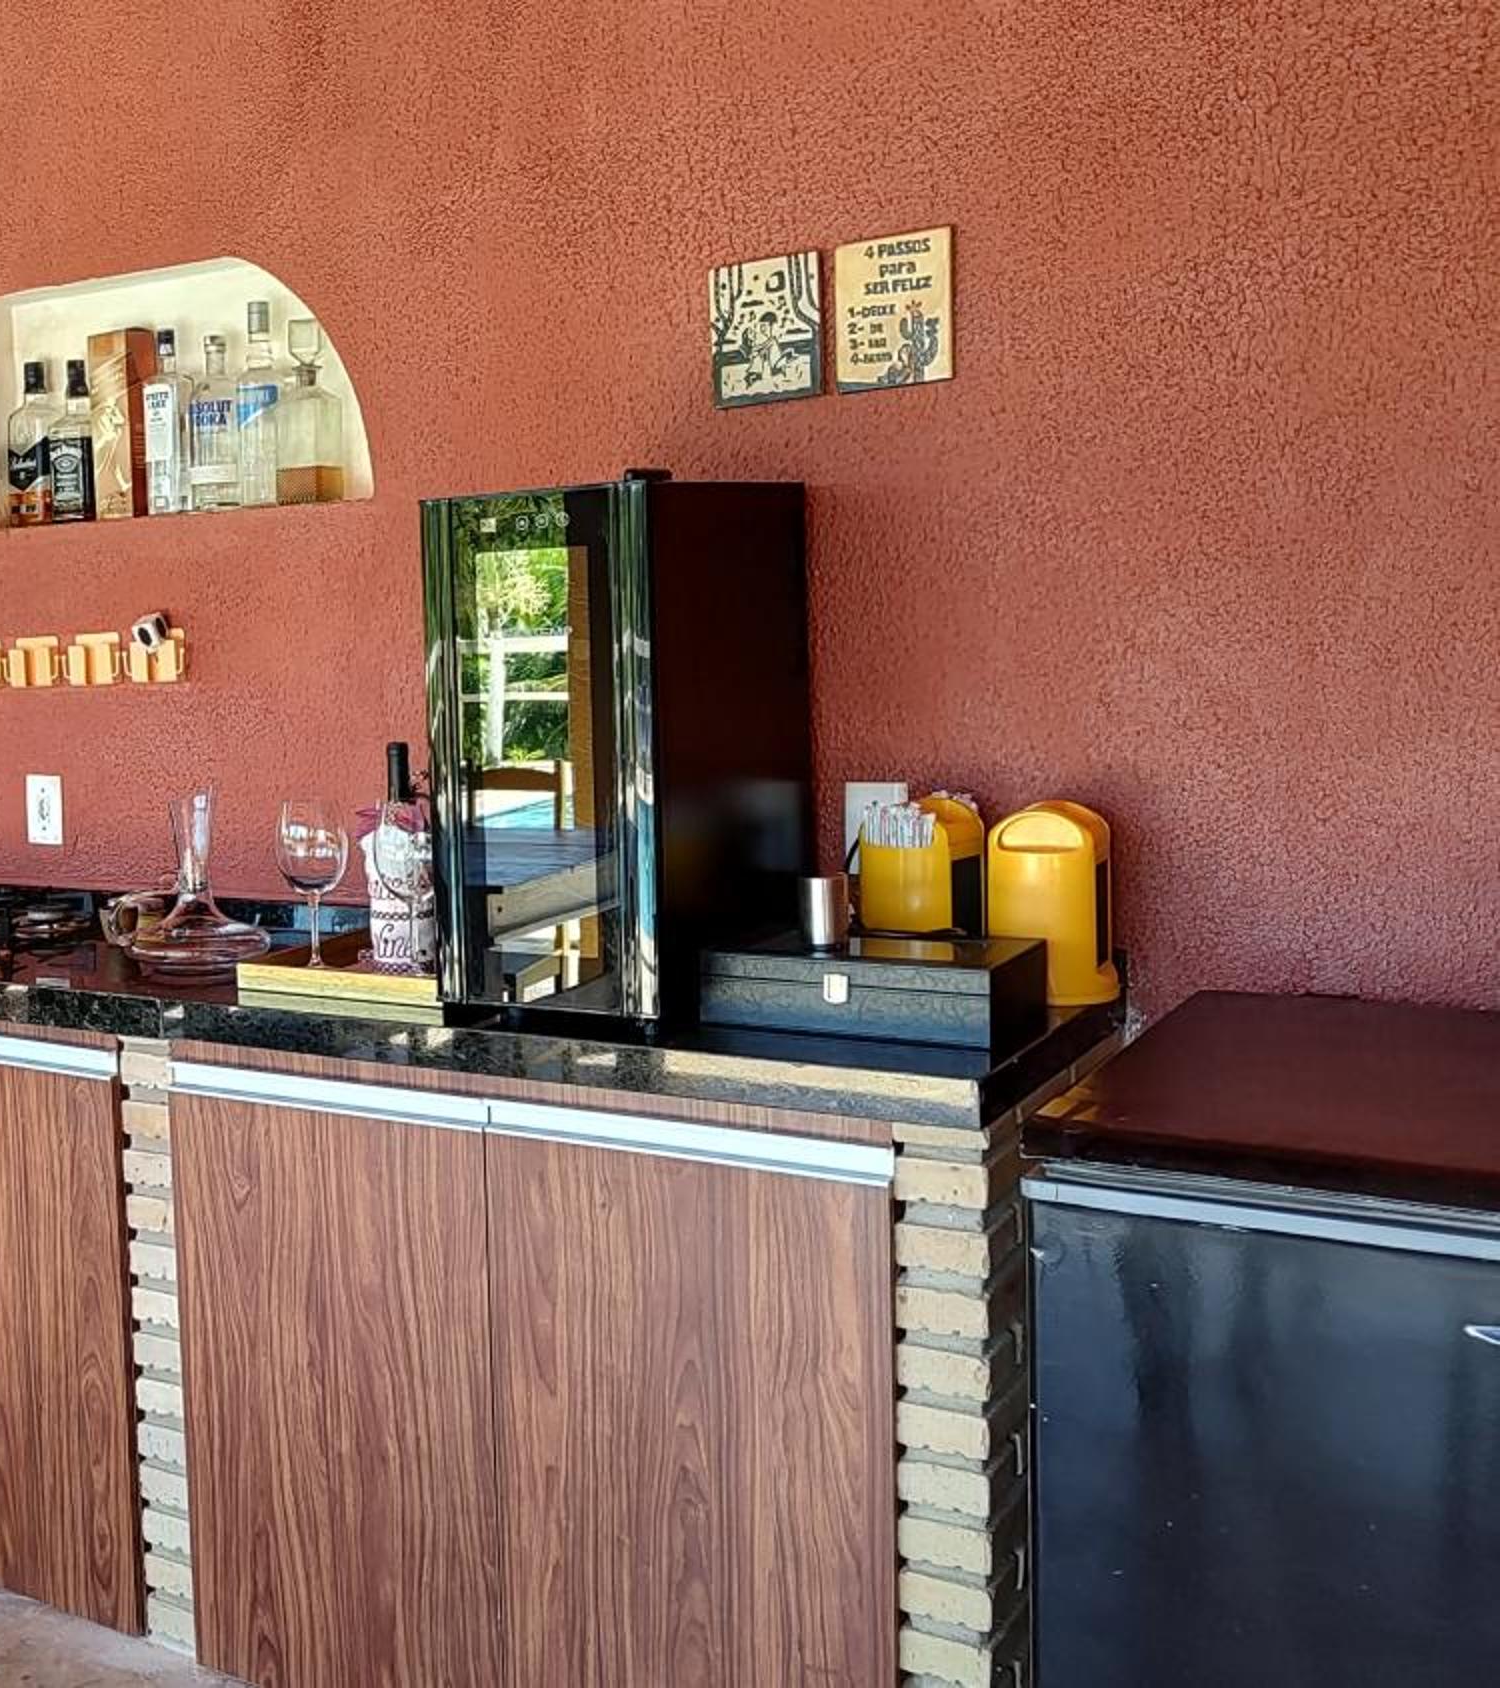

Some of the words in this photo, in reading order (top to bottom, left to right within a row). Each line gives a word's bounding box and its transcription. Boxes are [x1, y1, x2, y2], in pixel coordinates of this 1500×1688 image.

[864, 245, 874, 259] 4
[877, 237, 931, 259] PASSOS
[879, 261, 917, 278] para
